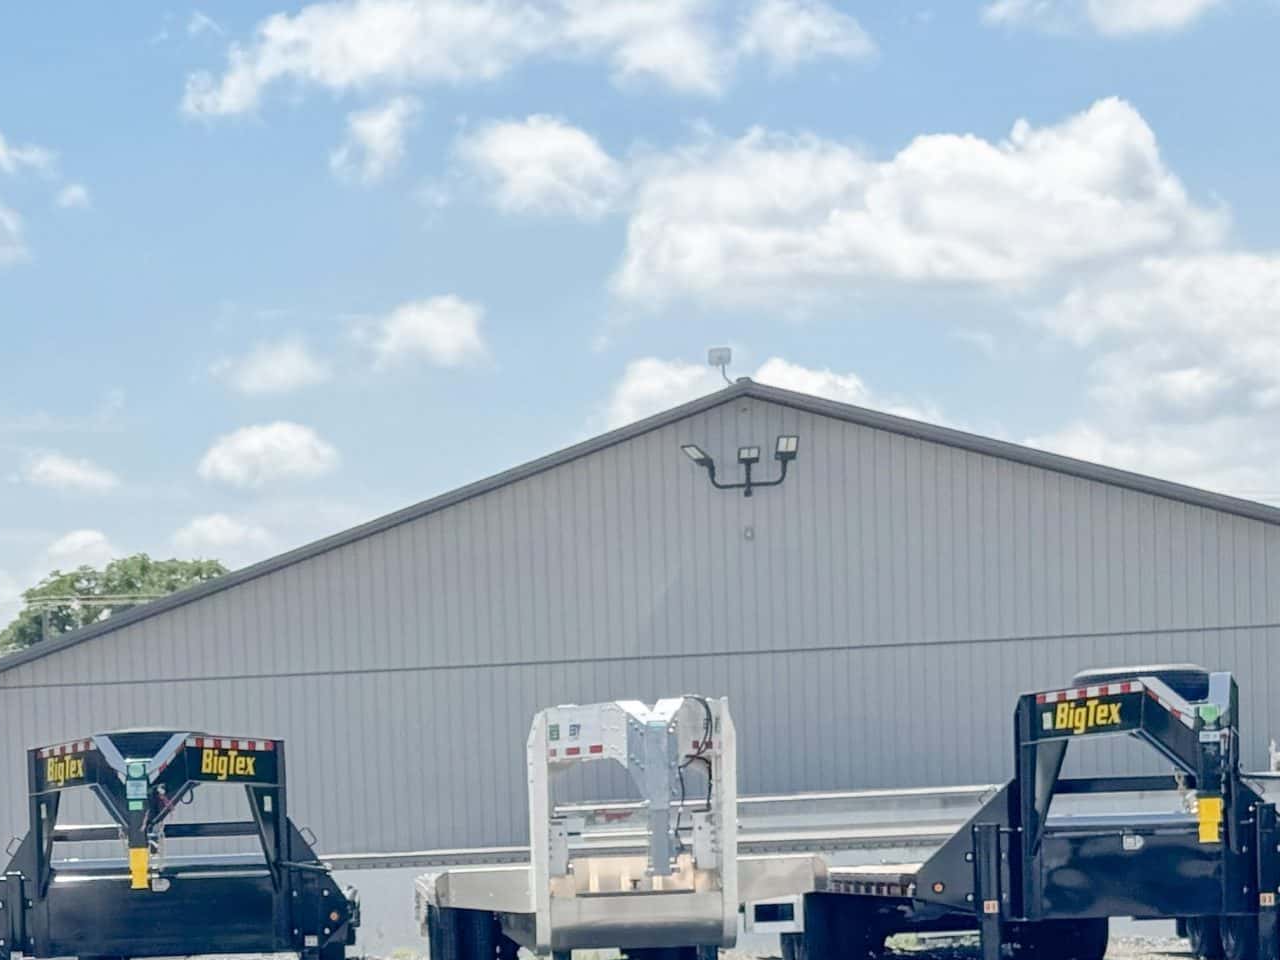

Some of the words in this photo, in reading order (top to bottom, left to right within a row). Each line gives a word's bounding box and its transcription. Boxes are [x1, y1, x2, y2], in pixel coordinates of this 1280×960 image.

[1055, 698, 1122, 735] BigTex
[46, 755, 84, 787] BigTex
[201, 749, 257, 780] BigTex
